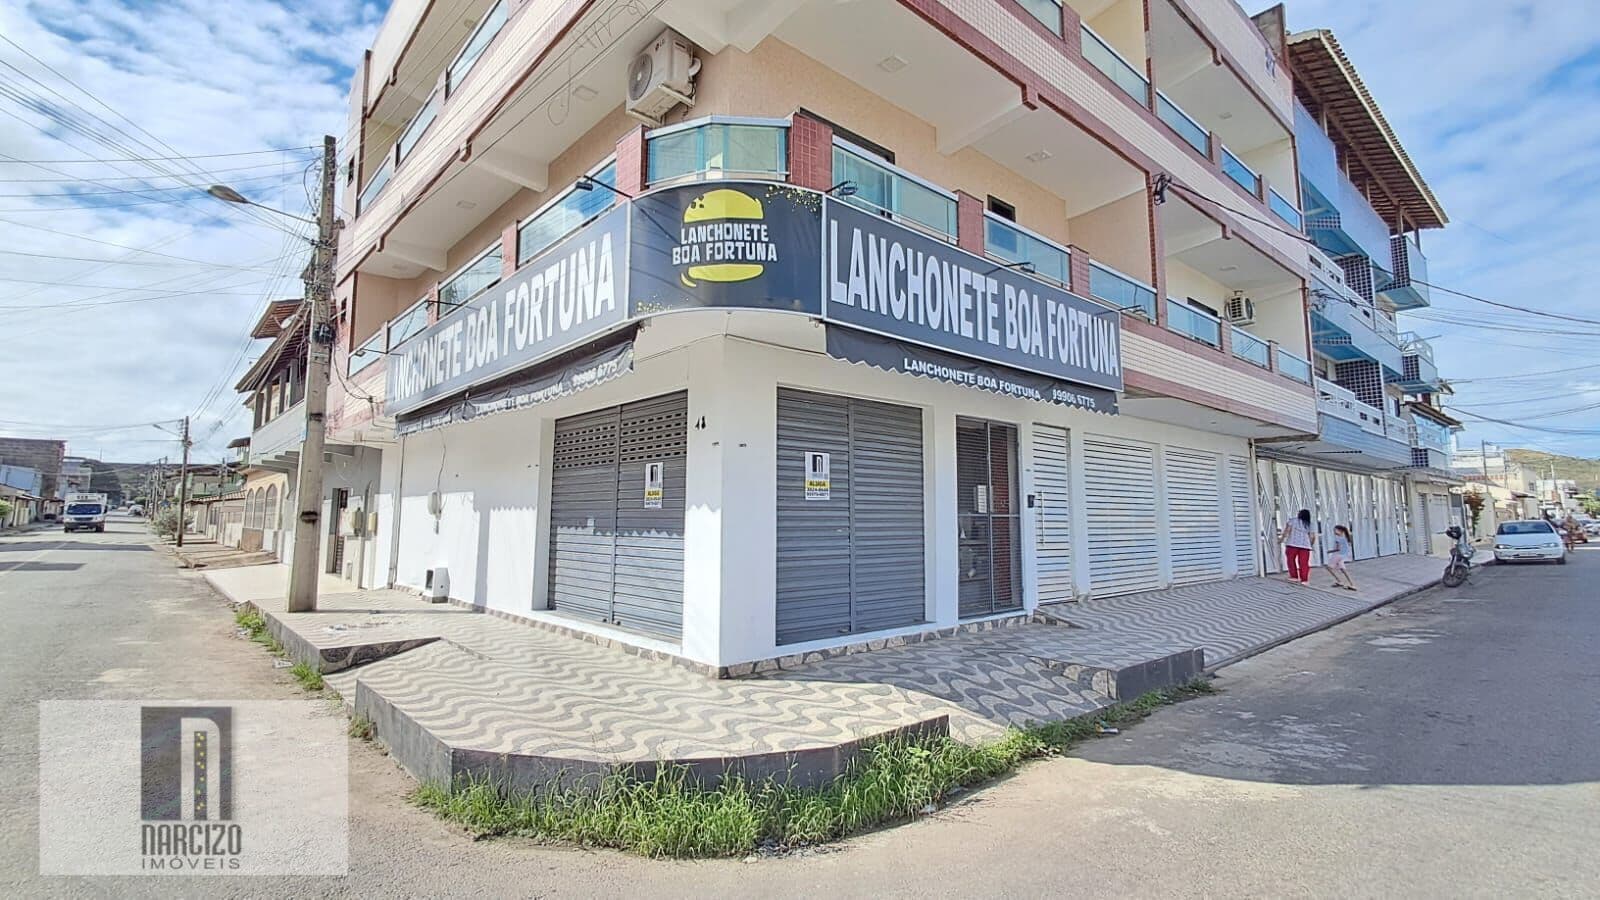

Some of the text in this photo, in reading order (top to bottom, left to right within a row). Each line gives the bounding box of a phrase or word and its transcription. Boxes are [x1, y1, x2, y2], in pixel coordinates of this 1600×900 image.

[672, 241, 778, 265] BOA FORTUNA
[681, 223, 769, 245] LANCHONETE
[465, 300, 498, 372] BOA
[503, 232, 615, 356] FORTUNA
[831, 219, 1119, 377] LANCHONETE BOA FORTUNA
[904, 357, 976, 384] LANCHONETE
[977, 375, 998, 389] BOA
[1000, 380, 1041, 400] FORTUNA
